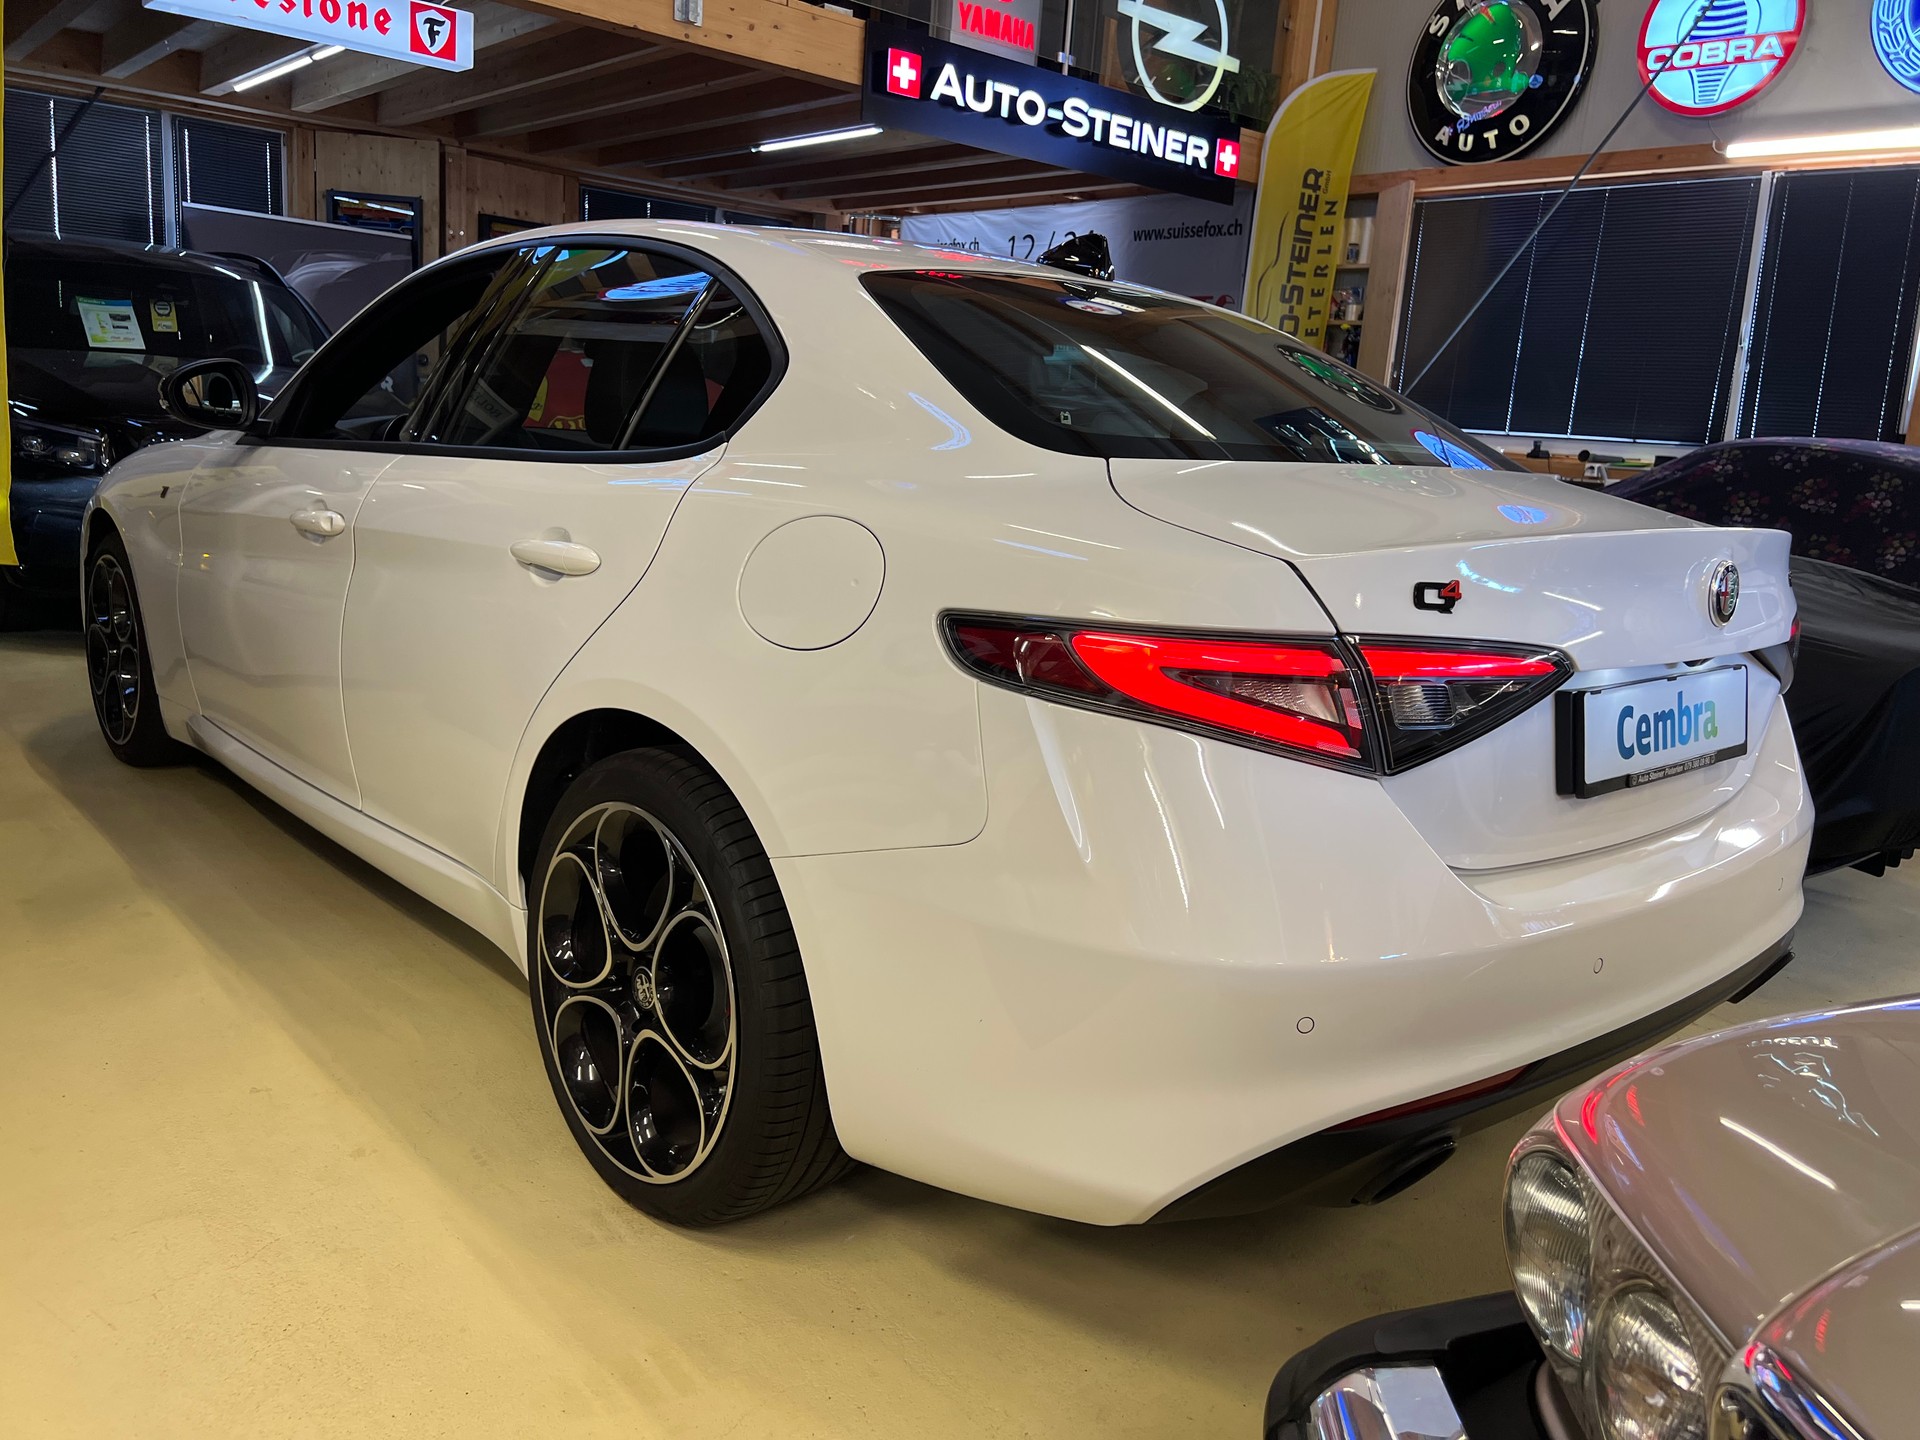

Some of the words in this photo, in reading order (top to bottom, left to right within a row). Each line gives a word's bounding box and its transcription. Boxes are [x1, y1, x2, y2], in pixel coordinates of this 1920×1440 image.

[958, 1, 1035, 52] YAMAHA
[1646, 35, 1784, 71] COBRA
[929, 63, 1210, 170] AUTO-STEINER
[1434, 114, 1531, 152] AUTO
[1132, 218, 1243, 242] www.suissefox.ch
[1413, 580, 1462, 614] Q4
[1616, 690, 1719, 760] Cembra
